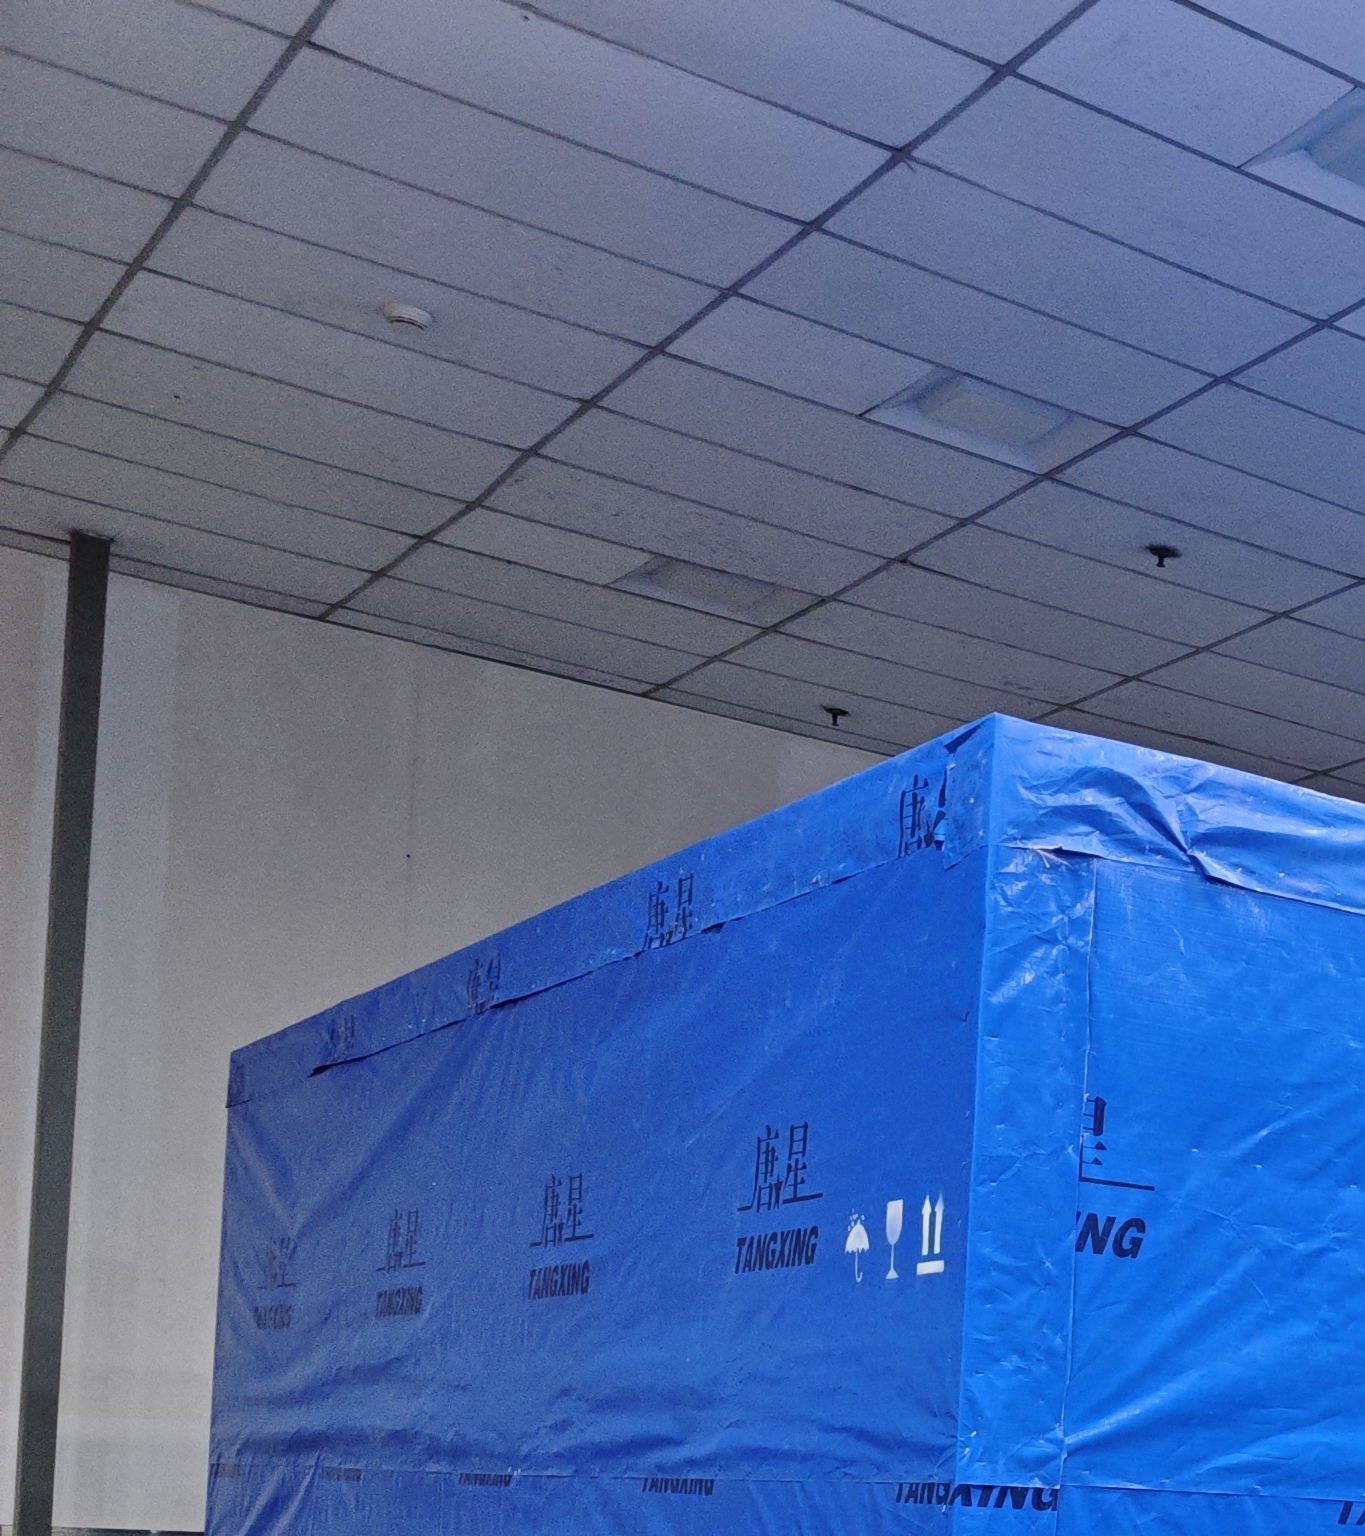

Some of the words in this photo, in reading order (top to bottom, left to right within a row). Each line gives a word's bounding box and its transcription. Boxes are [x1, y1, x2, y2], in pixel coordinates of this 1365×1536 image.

[737, 1121, 823, 1213] 唐星
[529, 1172, 594, 1248] 唐星
[734, 1225, 818, 1274] TANGXING
[375, 1286, 423, 1318] TANGXING
[528, 1260, 591, 1300] TANGXING
